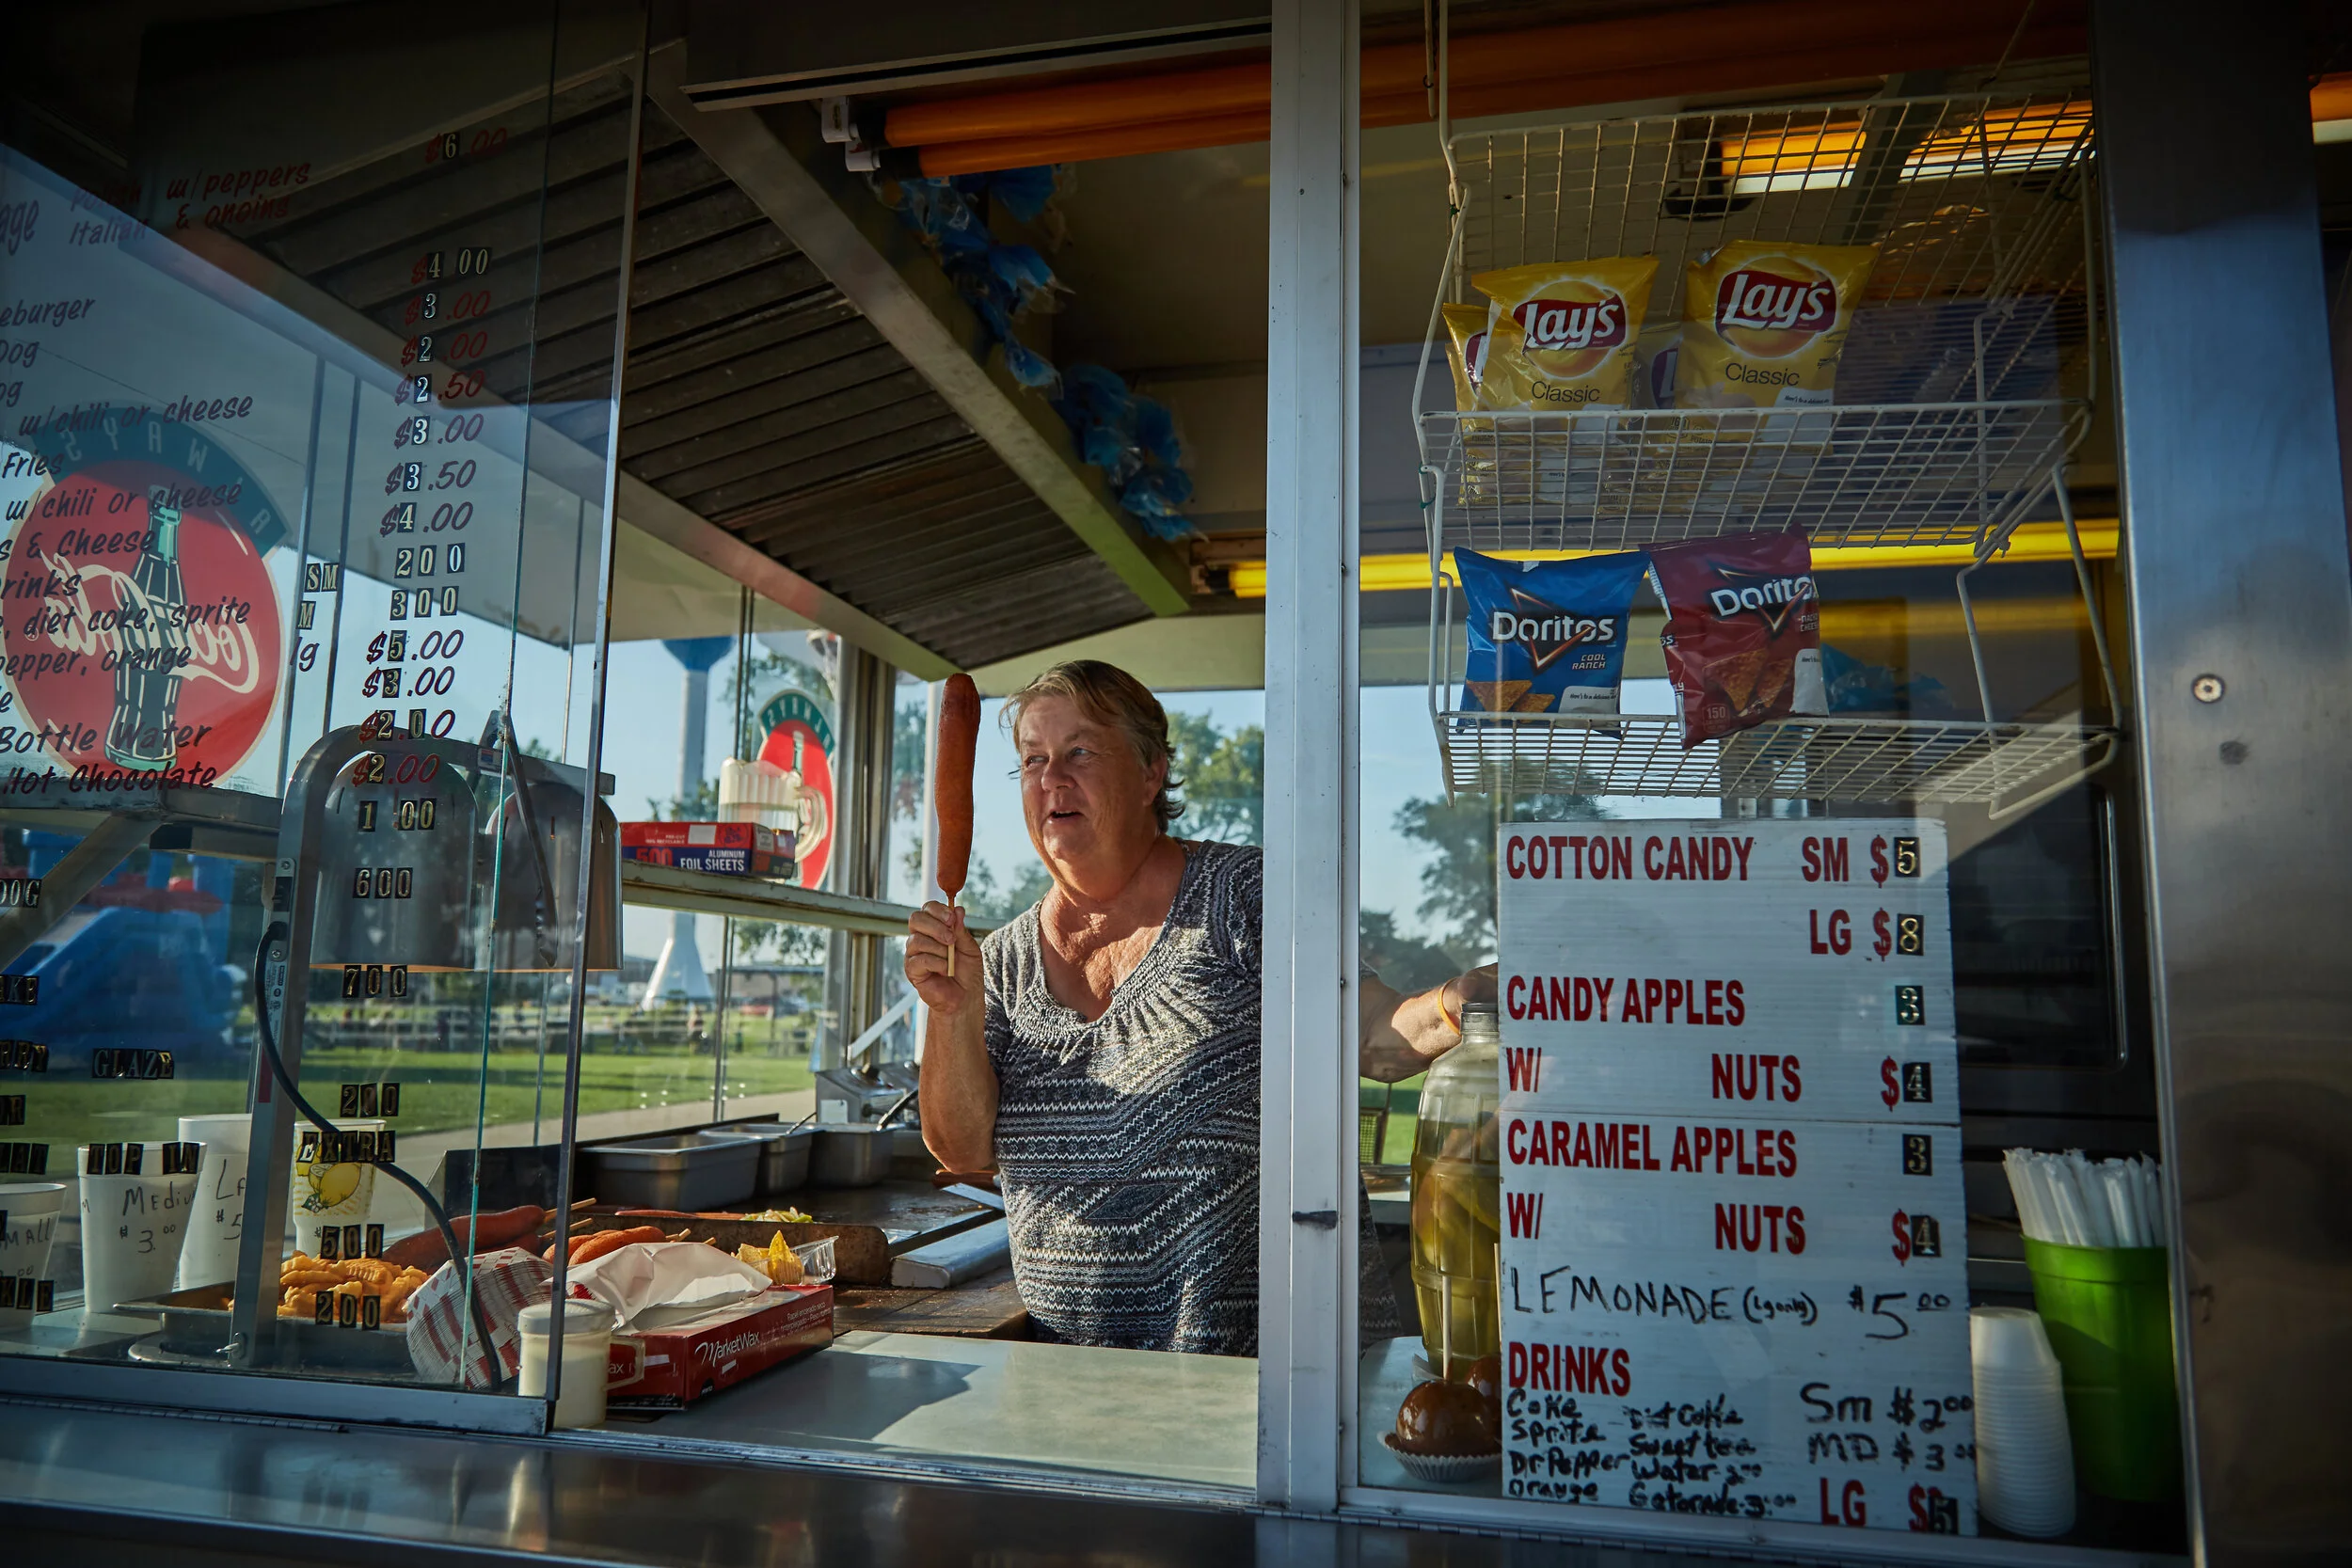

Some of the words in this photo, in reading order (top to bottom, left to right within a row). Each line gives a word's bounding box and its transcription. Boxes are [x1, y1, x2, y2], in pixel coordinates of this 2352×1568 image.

[69, 218, 151, 246] Italian
[176, 203, 190, 230] &
[1720, 274, 1831, 329] Lay's
[1522, 299, 1620, 351] Lay's
[1725, 362, 1801, 387] Classic
[1532, 380, 1601, 404] Classic
[120, 405, 151, 428] or
[163, 395, 254, 423] cheese
[2, 451, 65, 479] Fries
[107, 493, 139, 515] or
[150, 482, 244, 511] cheese
[26, 532, 41, 558] &
[57, 531, 156, 557] Cheese
[305, 563, 340, 592] SM
[1710, 576, 1820, 617] Dorito
[24, 607, 76, 636] diet
[87, 601, 156, 632] coke,
[169, 595, 252, 633] sprite
[296, 601, 316, 629] M
[1491, 611, 1615, 643] Doritos
[101, 645, 193, 674] orange
[1572, 661, 1607, 671] RANCH
[1581, 654, 1606, 662] COOL
[1707, 705, 1726, 720] 150
[0, 723, 99, 753] Bottle
[114, 721, 213, 750] Water
[3, 766, 58, 795] Hot
[69, 760, 218, 792] Chocolate
[680, 858, 704, 871] FOIL
[705, 858, 744, 872] SHEETS
[708, 849, 745, 858] ALUMINUM
[1506, 835, 1632, 880] COTTON
[1644, 836, 1754, 881] CANDY
[1802, 836, 1849, 882] SM
[1809, 909, 1851, 956] LG
[1506, 975, 1614, 1023] CANDY
[1621, 978, 1746, 1027] APPLES
[1897, 986, 1924, 1025] 3
[93, 1049, 174, 1079] GLAZE
[1505, 1047, 1542, 1093] W/
[1712, 1053, 1802, 1103] NUTS
[1507, 1118, 1661, 1171] CARAMEL
[1670, 1126, 1798, 1179] APPLES
[1903, 1134, 1931, 1175] 3
[1506, 1192, 1544, 1240] W/
[1714, 1203, 1806, 1256] NUTS
[1510, 1265, 1736, 1325] LEMONADE
[694, 1331, 759, 1368] MarketWax
[1509, 1341, 1631, 1397] DRINKS
[1807, 1432, 1879, 1465] MD
[1820, 1477, 1867, 1528] LG
